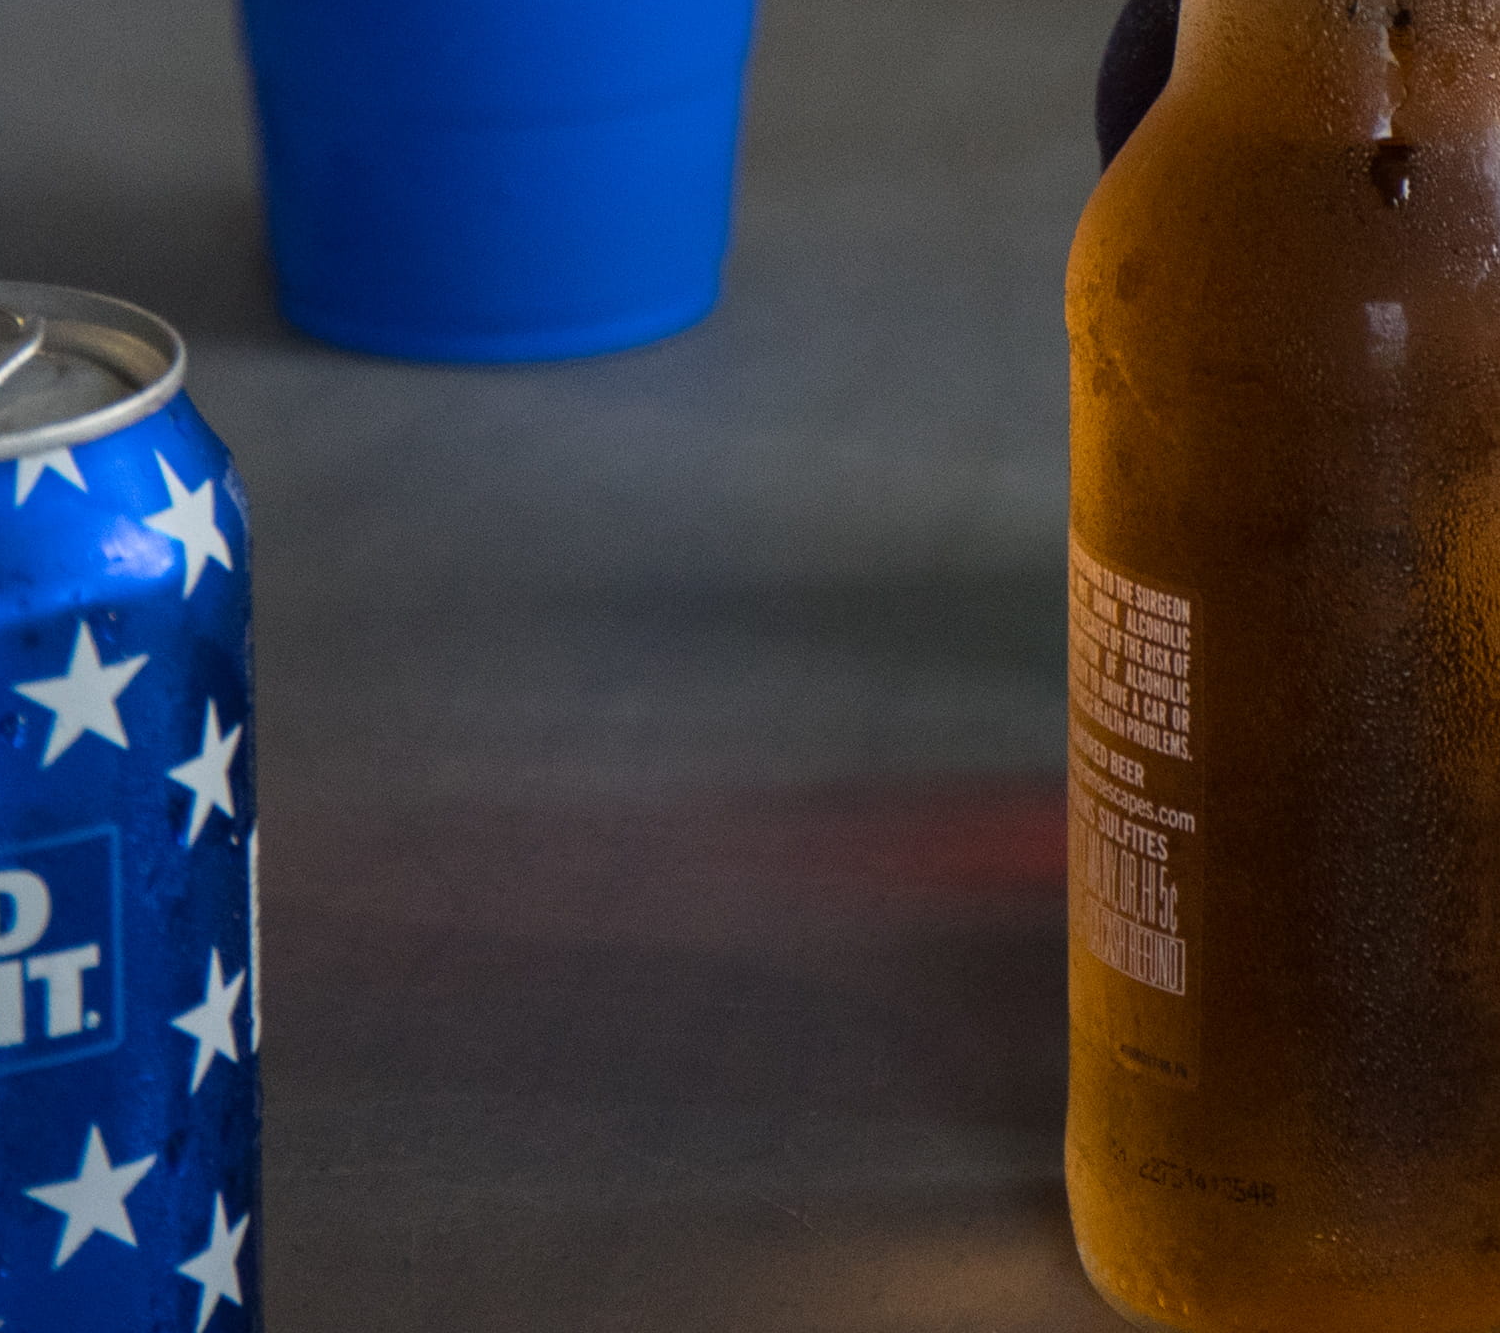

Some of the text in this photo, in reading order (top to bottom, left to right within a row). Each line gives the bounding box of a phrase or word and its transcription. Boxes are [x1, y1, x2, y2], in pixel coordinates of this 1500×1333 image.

[1116, 574, 1135, 605] THE
[1135, 583, 1190, 625] SURGEON
[1125, 606, 1191, 652] ALCOHOLIC
[1105, 649, 1118, 679] OF
[1125, 662, 1191, 706] ALCOHOLIC
[1123, 632, 1143, 663] THE
[1144, 641, 1171, 674] RISK
[1173, 653, 1191, 679] OF
[1102, 676, 1129, 712] DRIVE
[1131, 691, 1140, 717] A
[1143, 696, 1167, 728] CAR
[1172, 706, 1191, 734] OR
[1126, 715, 1194, 762] PROBLEMS.
[1110, 753, 1145, 788] BEER
[1098, 805, 1169, 862] SULFITES
[1128, 926, 1178, 991] REFUND
